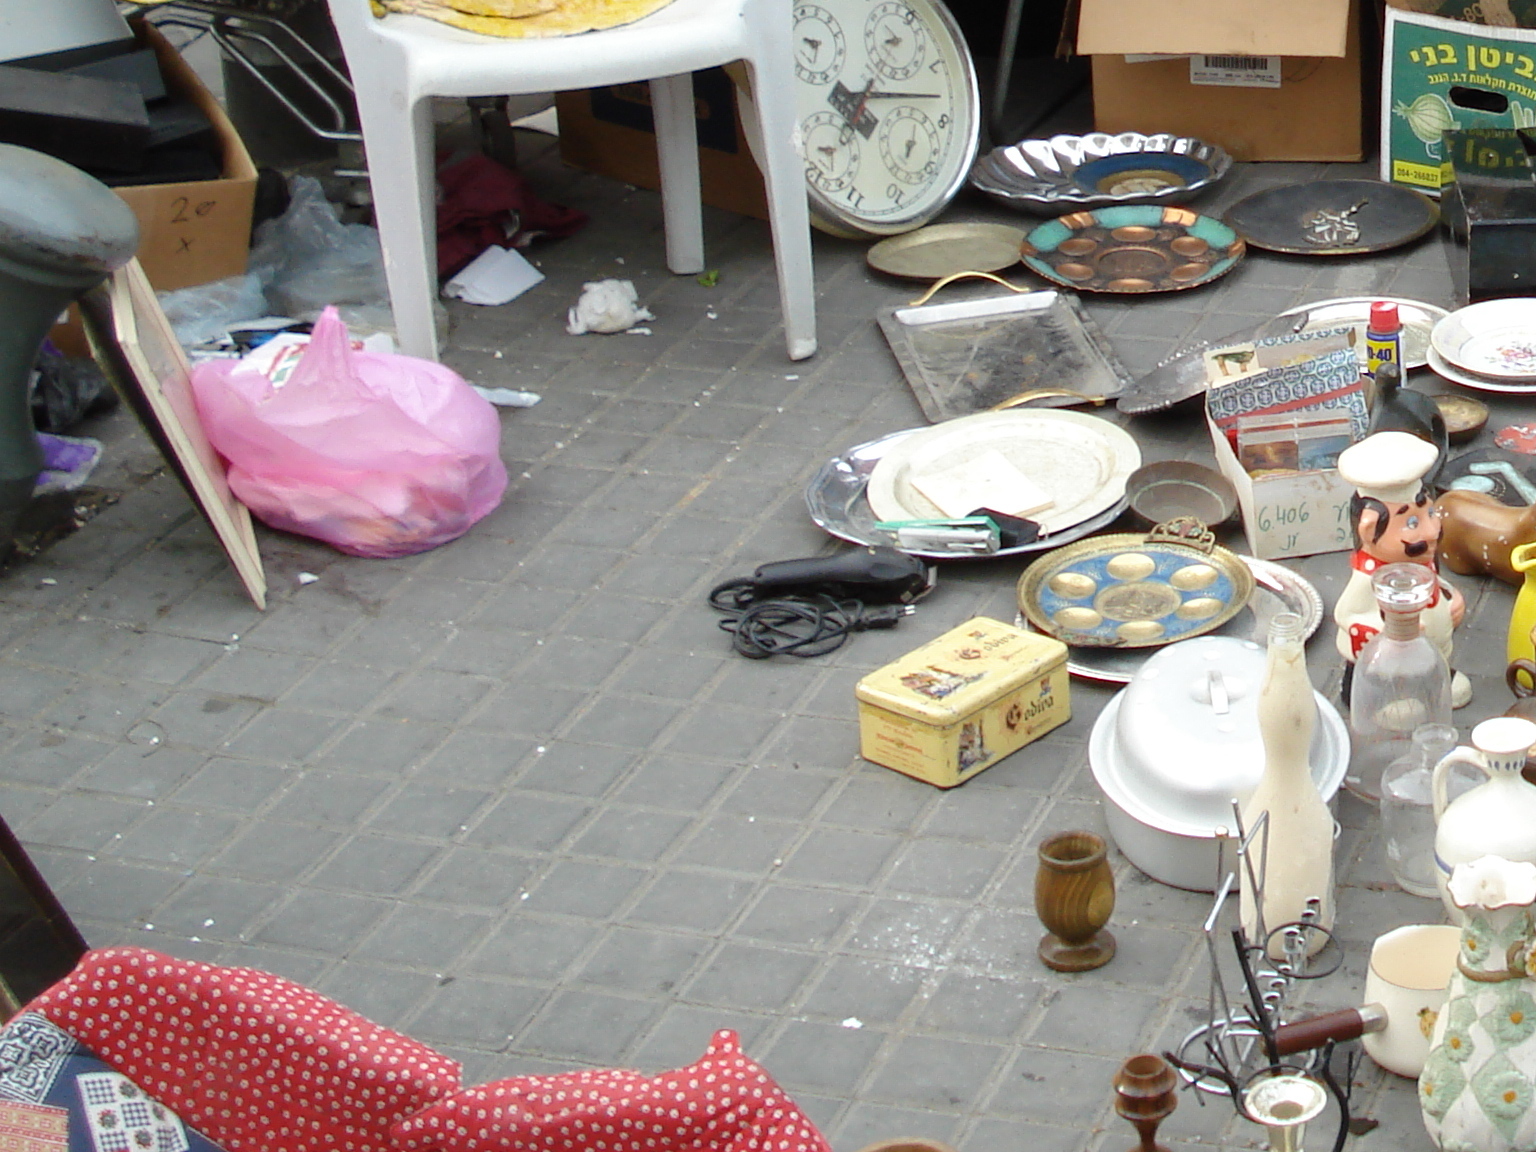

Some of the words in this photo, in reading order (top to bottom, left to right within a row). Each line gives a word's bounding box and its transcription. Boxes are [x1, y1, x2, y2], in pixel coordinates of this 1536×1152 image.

[1409, 44, 1458, 67] בני
[937, 113, 949, 129] 8
[1006, 696, 1054, 730] Godiva
